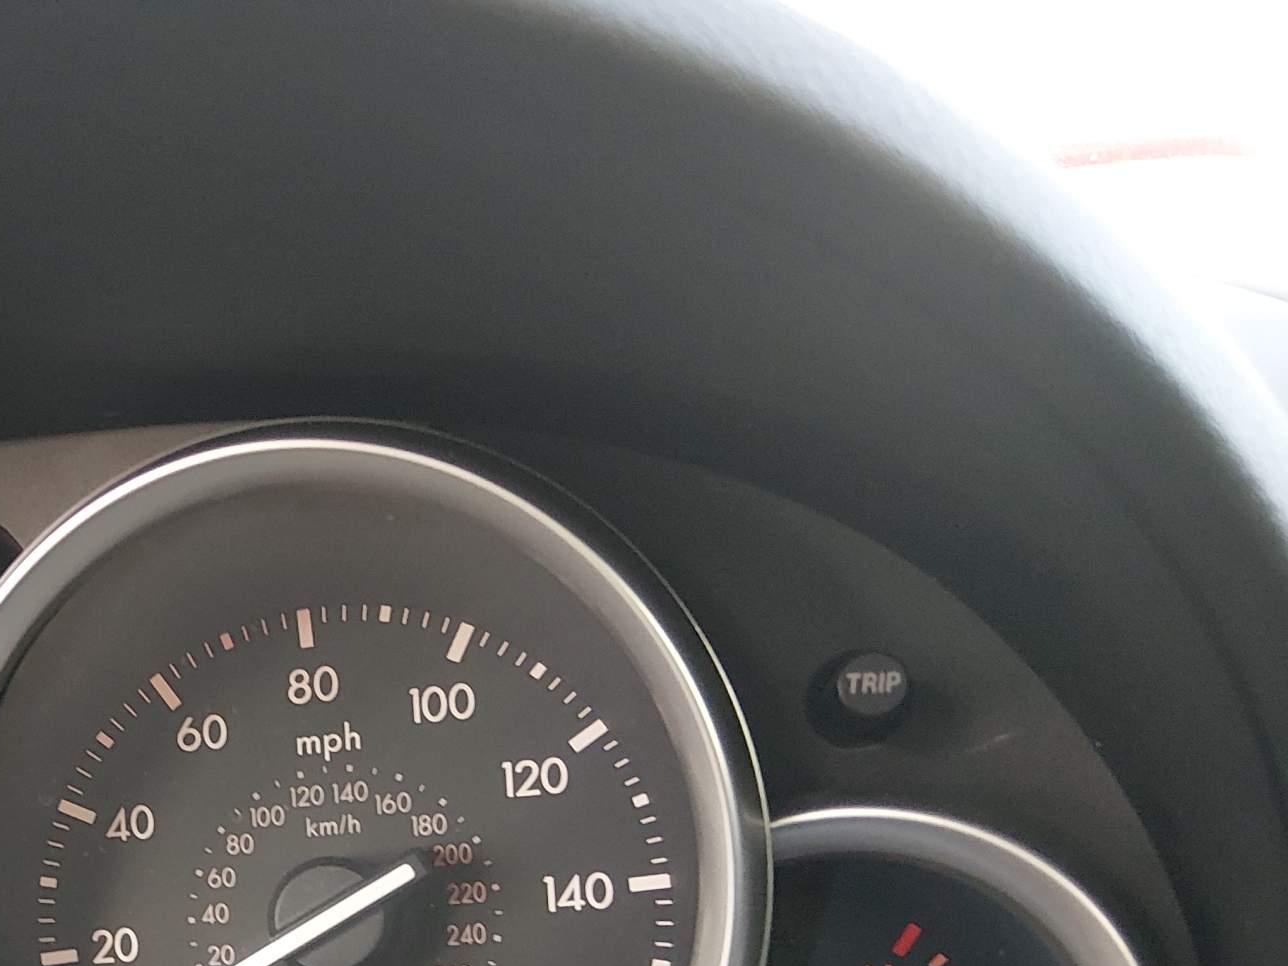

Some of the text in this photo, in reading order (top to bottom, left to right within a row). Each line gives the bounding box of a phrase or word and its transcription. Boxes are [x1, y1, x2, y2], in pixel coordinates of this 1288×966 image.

[287, 665, 339, 705] 80
[846, 670, 903, 695] TRIP
[408, 682, 475, 724] 100
[176, 714, 227, 753] 60
[295, 722, 361, 761] mph
[501, 756, 568, 799] 120
[290, 785, 324, 807] 120
[332, 780, 369, 804] 140
[375, 791, 412, 816] 160
[105, 804, 155, 840] 40
[249, 805, 285, 829] 100
[305, 814, 362, 838] km/h
[412, 812, 447, 837] 180
[226, 833, 254, 856] 80
[433, 842, 473, 867] 200
[208, 866, 236, 889] 60
[446, 881, 486, 905] 220
[543, 872, 614, 913] 140
[202, 902, 230, 925] 40
[446, 922, 487, 946] 240
[92, 929, 139, 965] 20
[208, 944, 236, 966] 20
